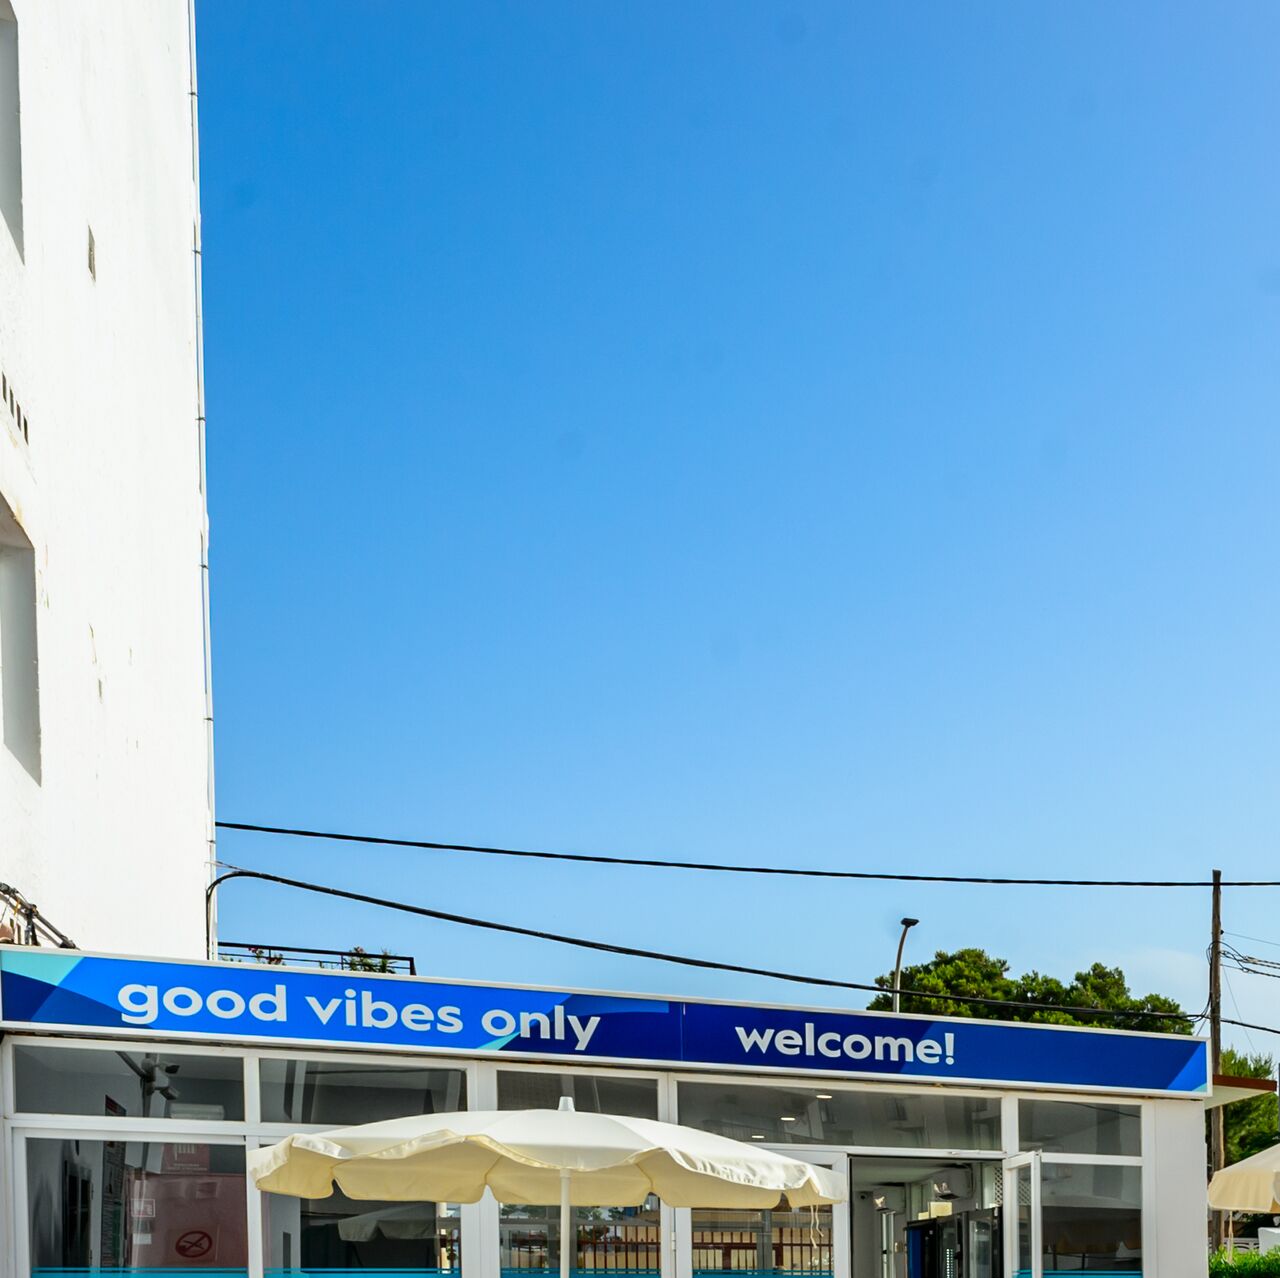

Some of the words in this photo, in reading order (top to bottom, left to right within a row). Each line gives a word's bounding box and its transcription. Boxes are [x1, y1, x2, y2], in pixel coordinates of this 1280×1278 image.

[118, 983, 287, 1025] good
[306, 989, 463, 1033] vibes
[481, 1004, 601, 1051] only
[735, 1022, 956, 1065] welcome!
